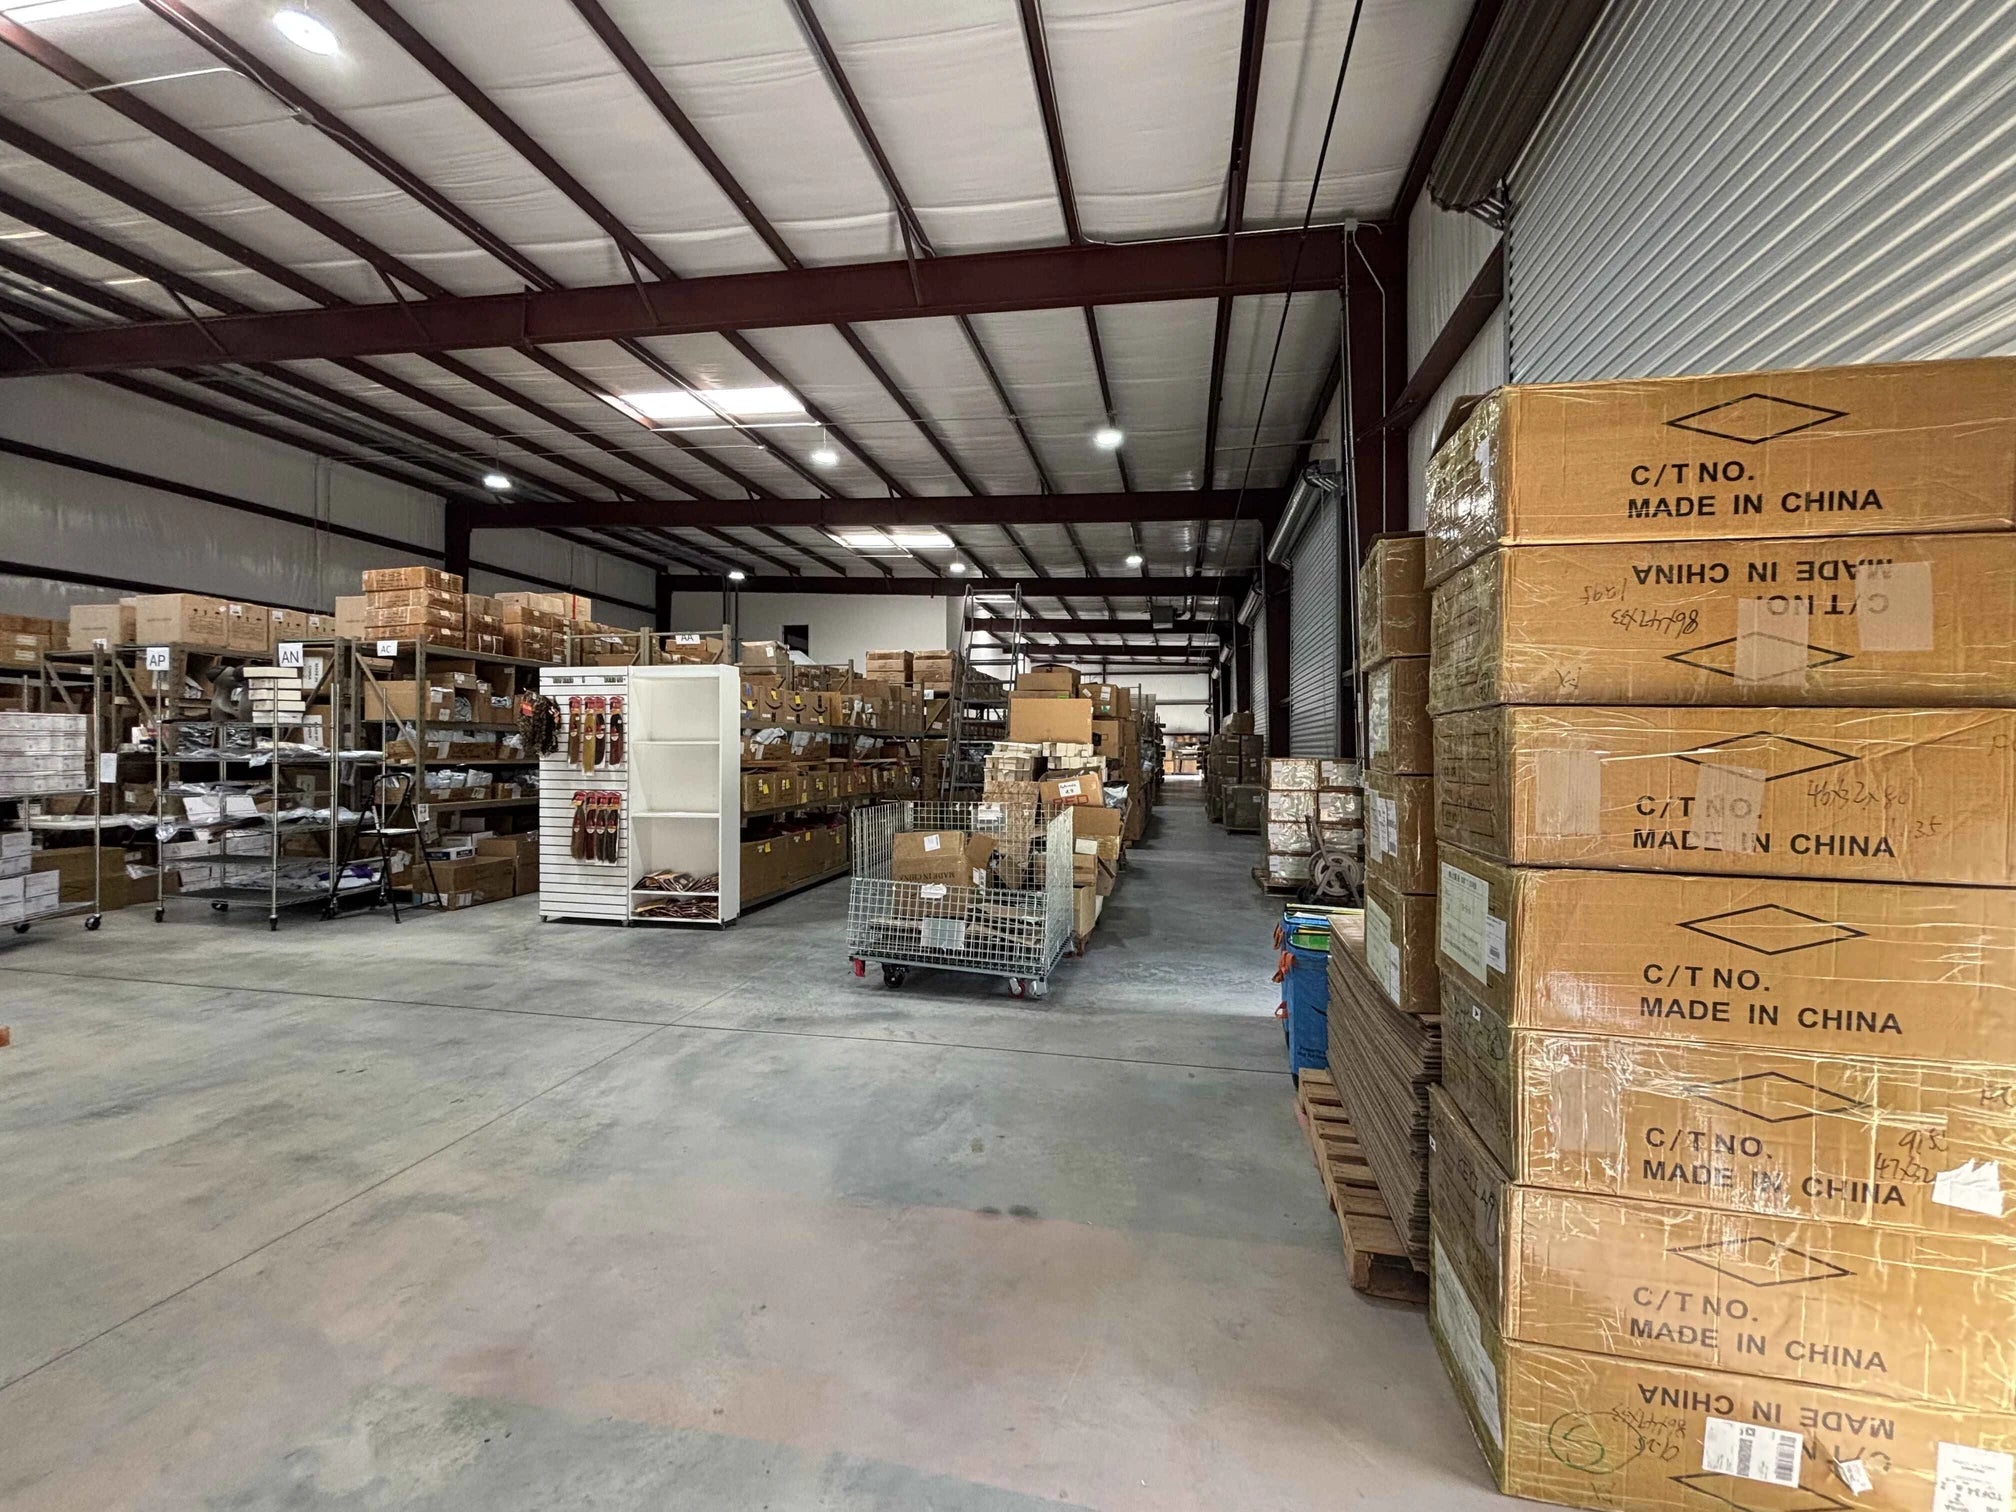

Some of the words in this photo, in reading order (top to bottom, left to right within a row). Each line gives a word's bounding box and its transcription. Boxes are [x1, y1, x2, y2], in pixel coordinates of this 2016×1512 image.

[1630, 463, 1689, 487] C/T
[1698, 460, 1755, 483] NO.
[1627, 495, 1716, 518] MADE
[1733, 493, 1763, 515] IN
[1781, 489, 1883, 513] CHINA
[1631, 562, 1729, 585] CHINA
[1748, 561, 1777, 582] IN
[149, 653, 166, 667] AP
[281, 650, 299, 664] AN
[381, 645, 391, 654] AC
[1636, 795, 1696, 818] C/T
[1789, 832, 1896, 858] CHINA
[1643, 963, 1703, 988] C/T
[1712, 967, 1770, 992] NO.
[1639, 996, 1731, 1023] MADE
[1748, 1003, 1778, 1026] IN
[1797, 1006, 1903, 1035] CHINA
[1645, 1127, 1706, 1152] C/T
[1714, 1133, 1773, 1159] NO.
[1642, 1158, 1735, 1189] MADE
[1751, 1169, 1783, 1193] IN
[1801, 1175, 1906, 1207] CHINA
[1632, 1286, 1694, 1312] C/T
[1702, 1295, 1758, 1322] NO.
[1629, 1316, 1719, 1349] MADE
[1736, 1332, 1767, 1356] IN
[1784, 1339, 1888, 1373] CHINA
[1636, 1383, 1735, 1416] CHINA
[1752, 1400, 1782, 1423] IN
[1799, 1406, 1895, 1441] MADE
